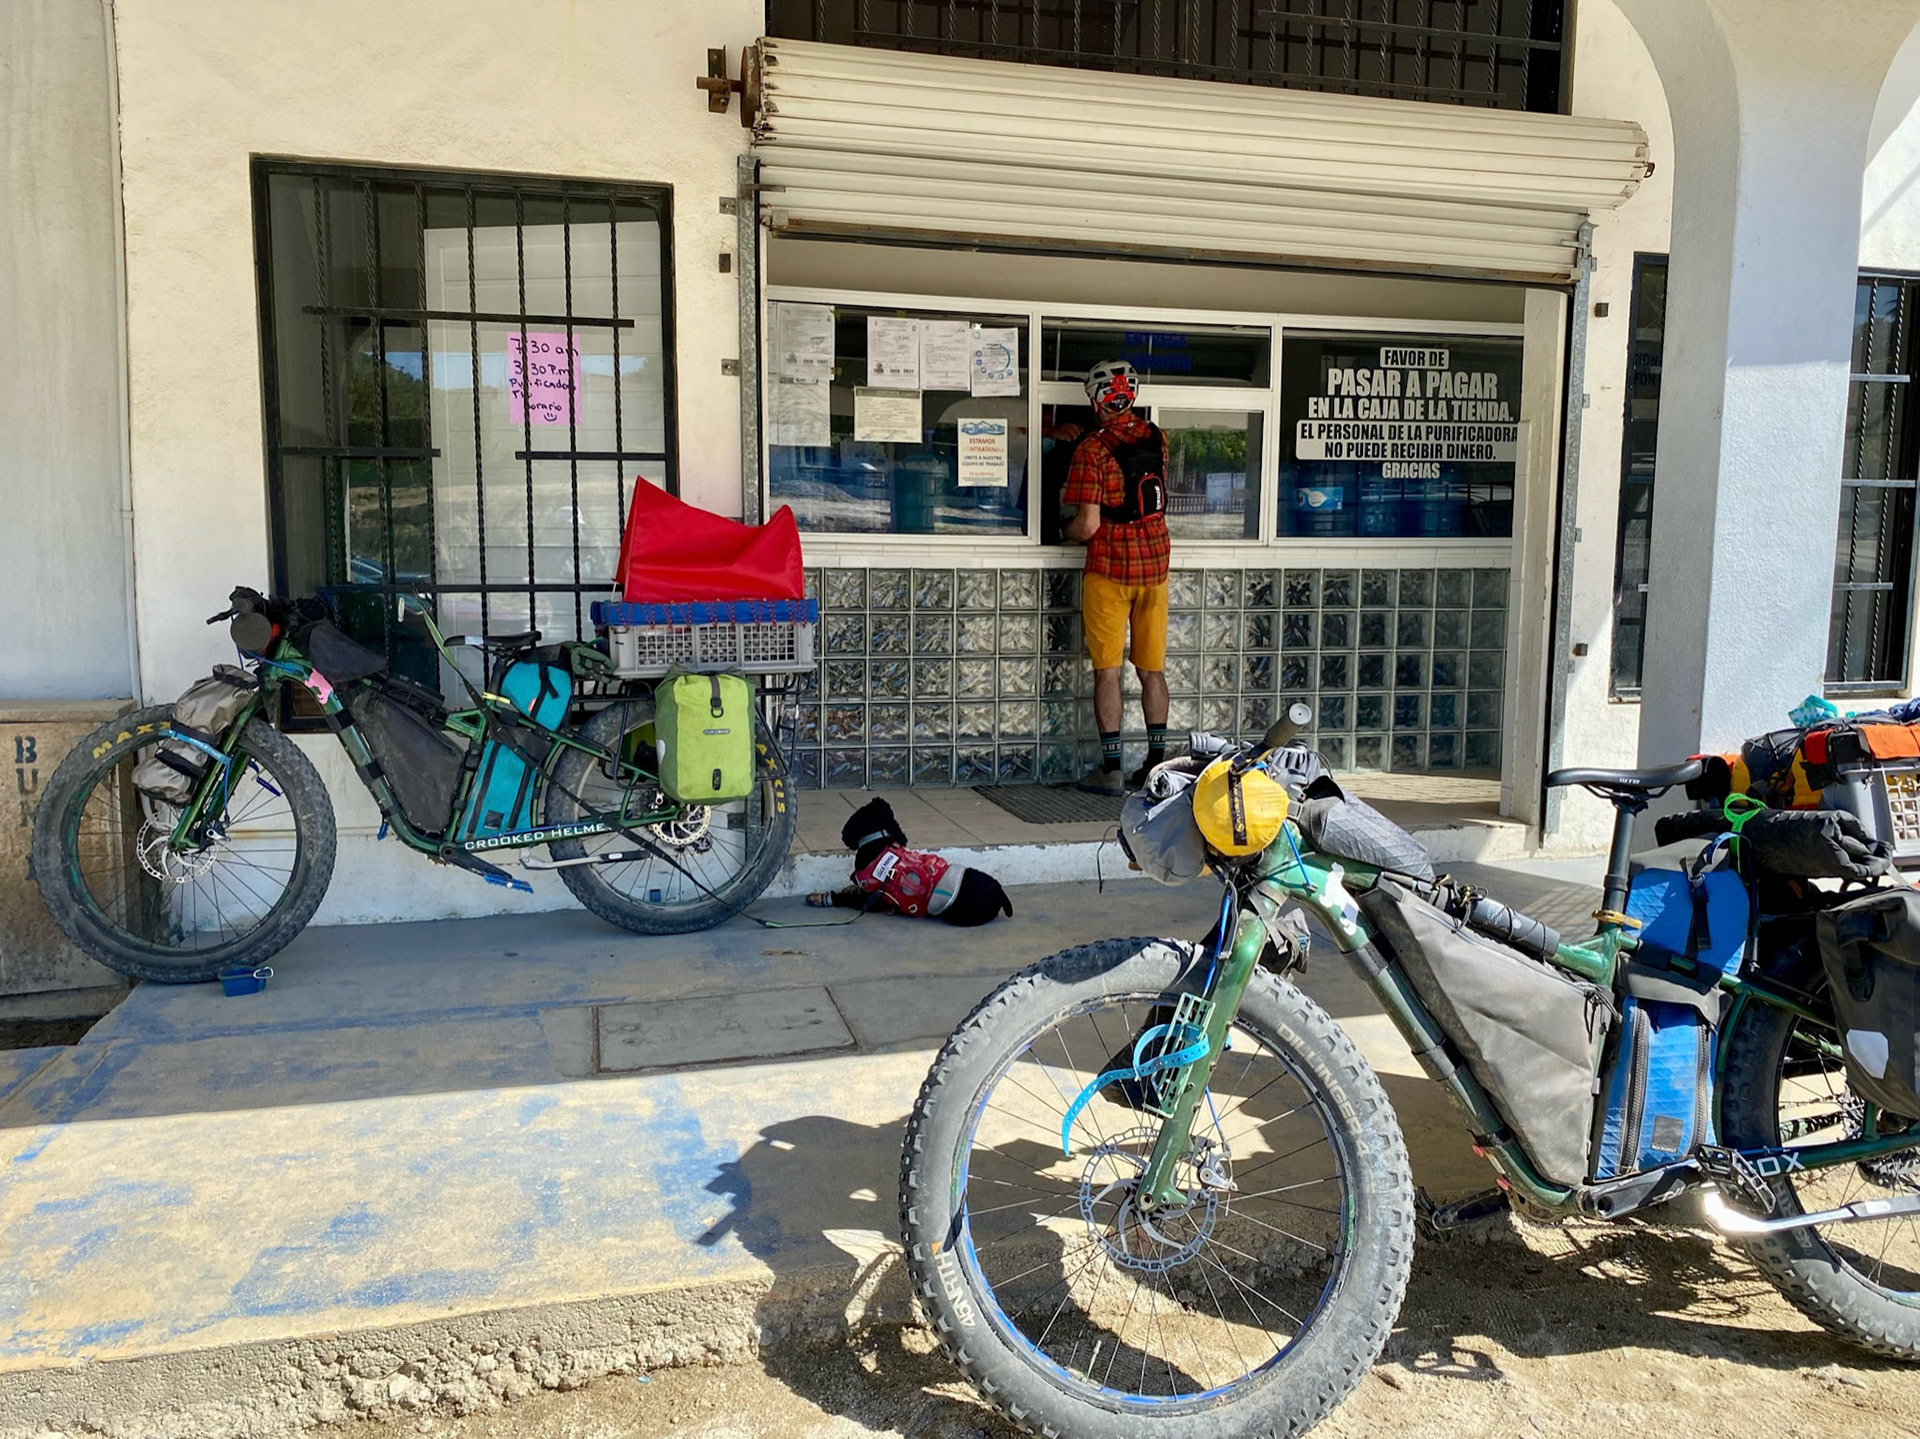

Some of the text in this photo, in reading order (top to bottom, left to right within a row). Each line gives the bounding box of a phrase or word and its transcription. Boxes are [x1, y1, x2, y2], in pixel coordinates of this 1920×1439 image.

[510, 338, 550, 354] 730
[1384, 350, 1445, 367] FAVOR DE
[1327, 369, 1498, 399] PASAR A PAGAR
[1308, 397, 1514, 422] EN LA CAJA DE LA TIENDA.
[1300, 423, 1518, 443] EL PERSONAL DE LA PURIFICADORA
[1324, 444, 1496, 461] NO PUEDE RECIBIR DINERO.
[1382, 462, 1441, 479] GRACIAS
[464, 822, 612, 851] CROOKED HELME
[1276, 1020, 1364, 1135] DILLINGER
